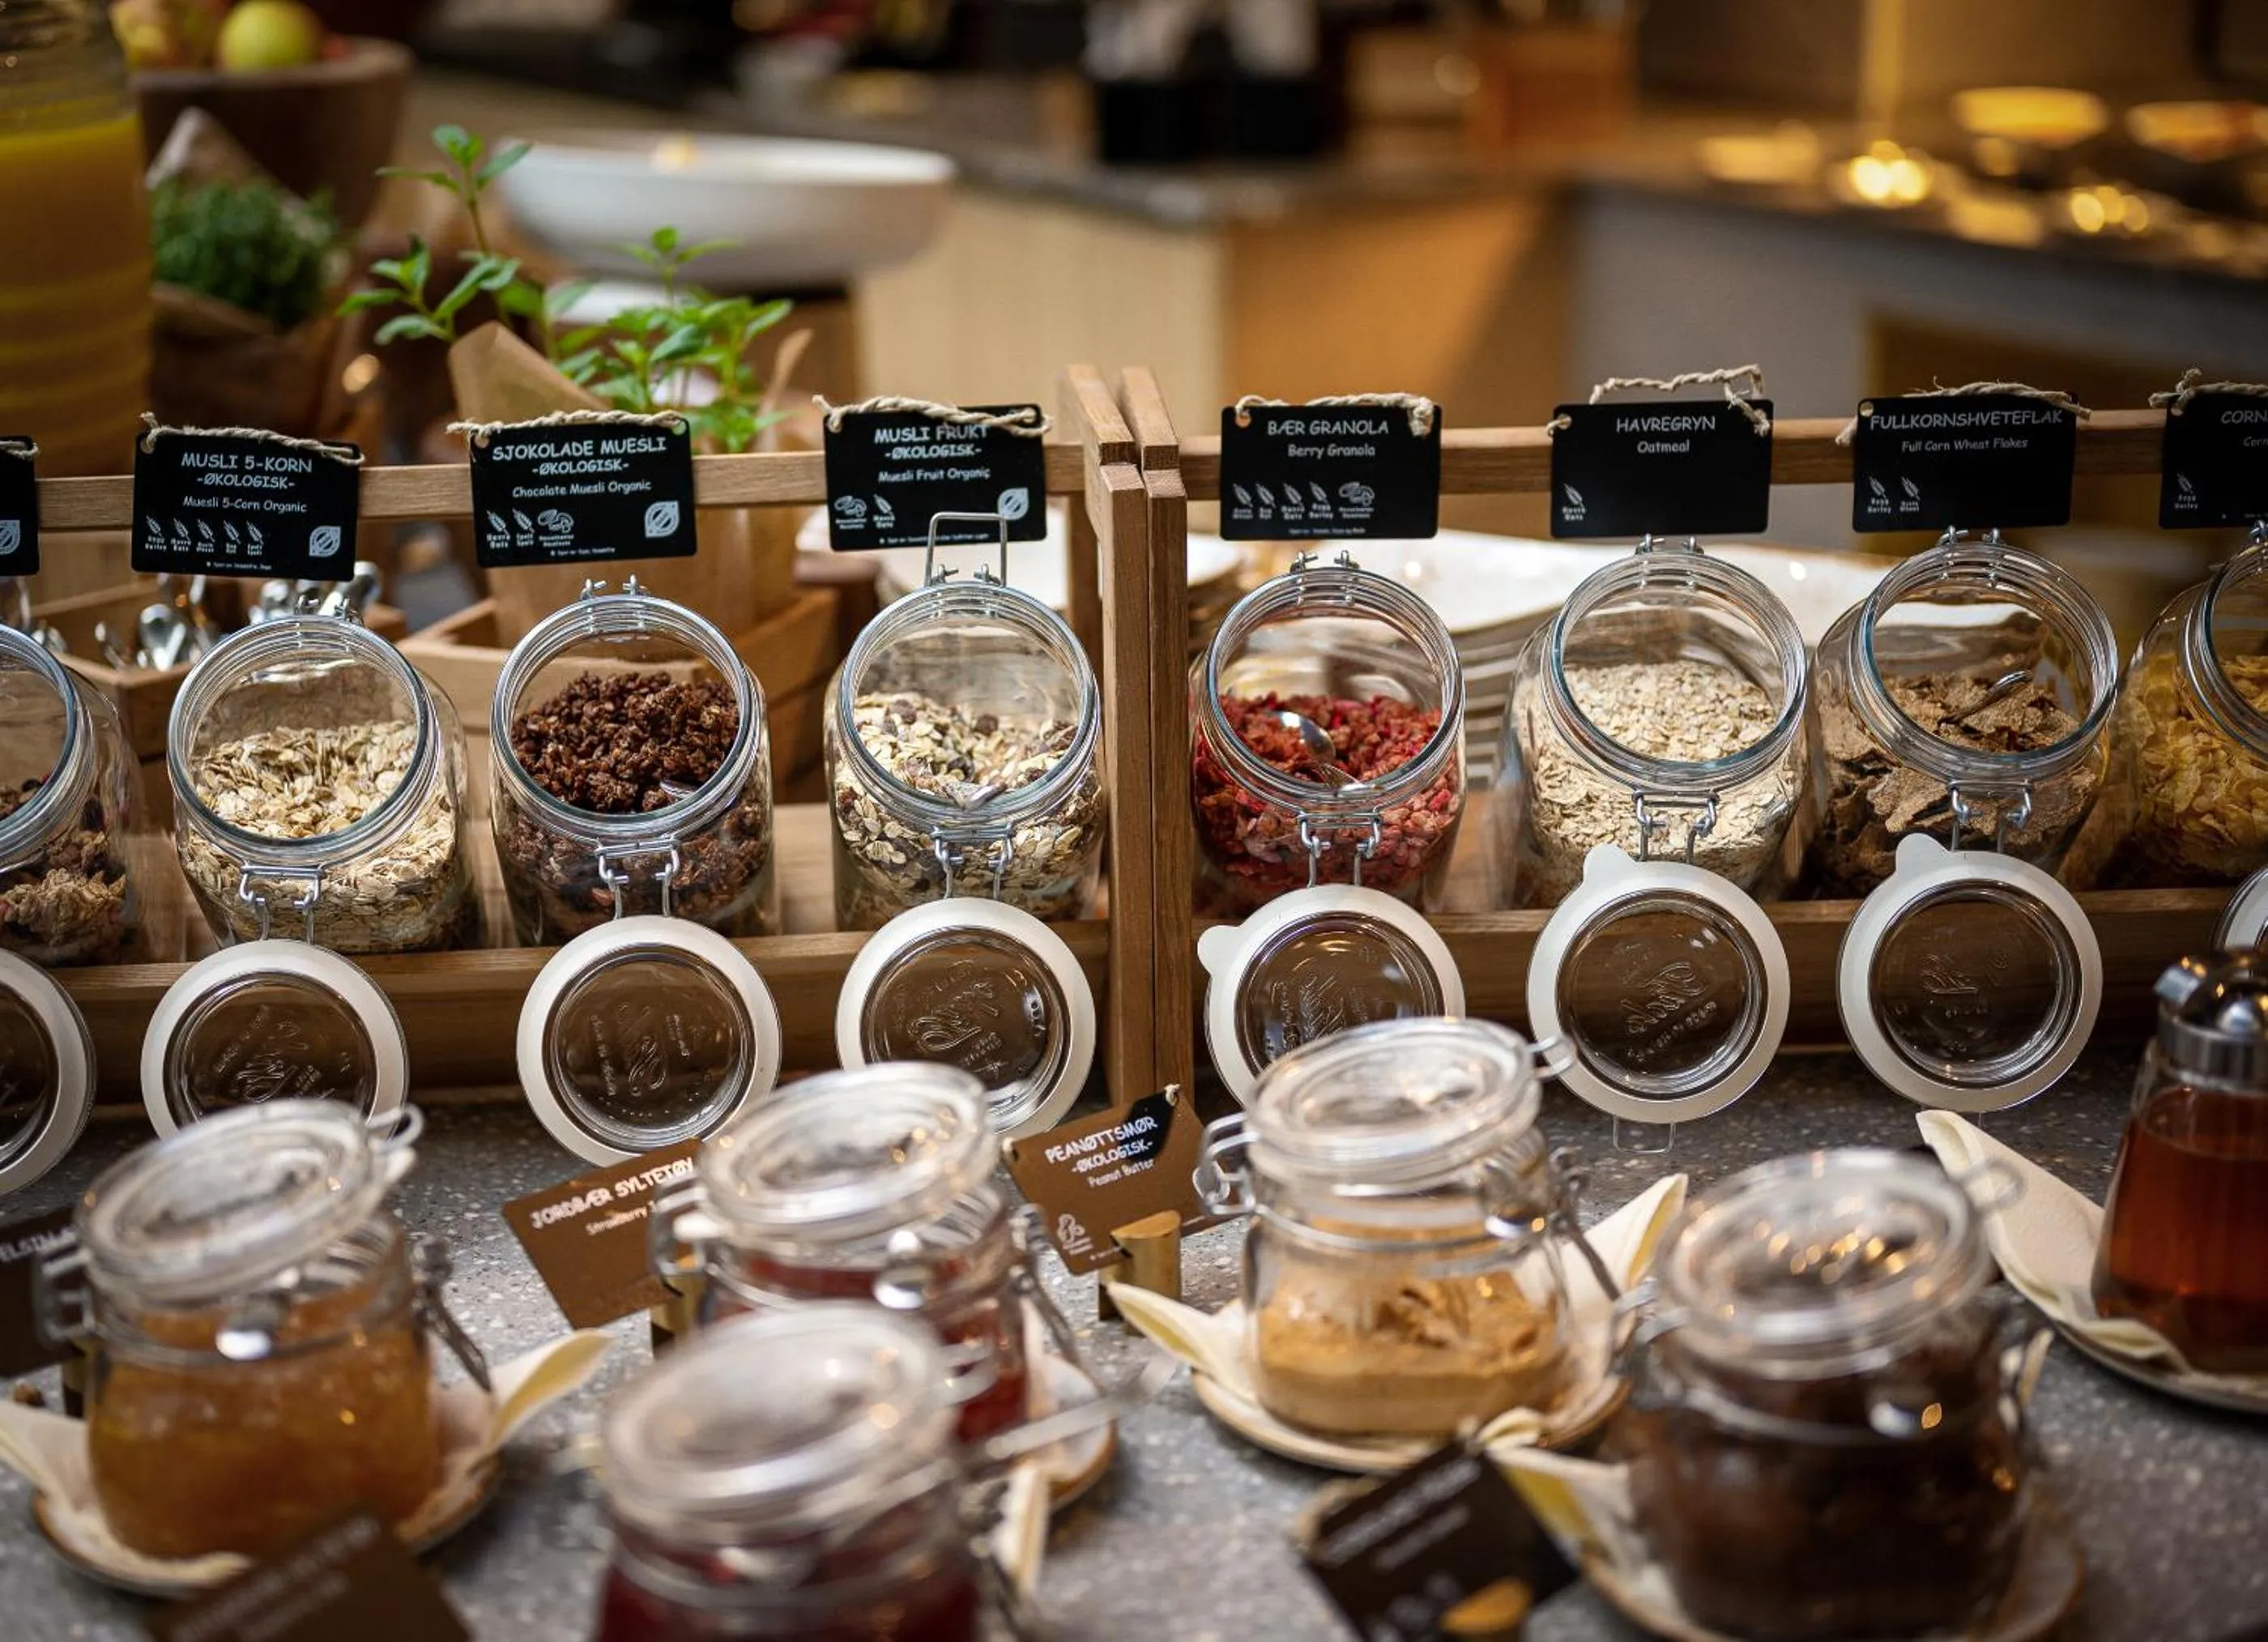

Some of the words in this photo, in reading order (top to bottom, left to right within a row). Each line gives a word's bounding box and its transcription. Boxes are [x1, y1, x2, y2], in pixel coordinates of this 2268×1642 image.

[1267, 420, 1305, 436] BÆR
[1310, 420, 1388, 436] GRANOLA
[1616, 416, 1716, 433] HAVREGRYN
[1869, 410, 2063, 431] FULLKORNSHVETEFLAK
[874, 427, 931, 444] MUSLI
[936, 424, 991, 441] FRUKT
[492, 441, 594, 461] SJOKOLADE
[600, 437, 667, 455] MUESLI
[885, 443, 982, 459] -ØKOLOGISK-
[1288, 444, 1324, 459] Berry
[1327, 444, 1375, 458] Granola
[1637, 440, 1690, 454] Oatmeal
[1901, 440, 1922, 454] Full
[1954, 438, 1990, 451] Wheat
[1993, 437, 2029, 449] Flakes
[181, 451, 238, 469] MUSLI
[245, 455, 313, 473] 5-KORN
[531, 458, 629, 476] -ØKOLOGISK-
[196, 472, 296, 490] -ØKOLOGISK-
[878, 470, 914, 483] Muesli
[916, 469, 944, 481] Fruit
[947, 467, 991, 481] Organic
[513, 485, 567, 498] Chocolate
[569, 482, 605, 495] Muesli
[608, 480, 652, 495] Organic
[222, 497, 260, 510] 5-Corn
[263, 500, 308, 514] Organic
[1044, 1115, 1158, 1164] PEANØTTSMØR
[614, 1157, 694, 1198] SYLTETØY
[1087, 1169, 1123, 1188] Peanut
[1121, 1158, 1154, 1176] Butter
